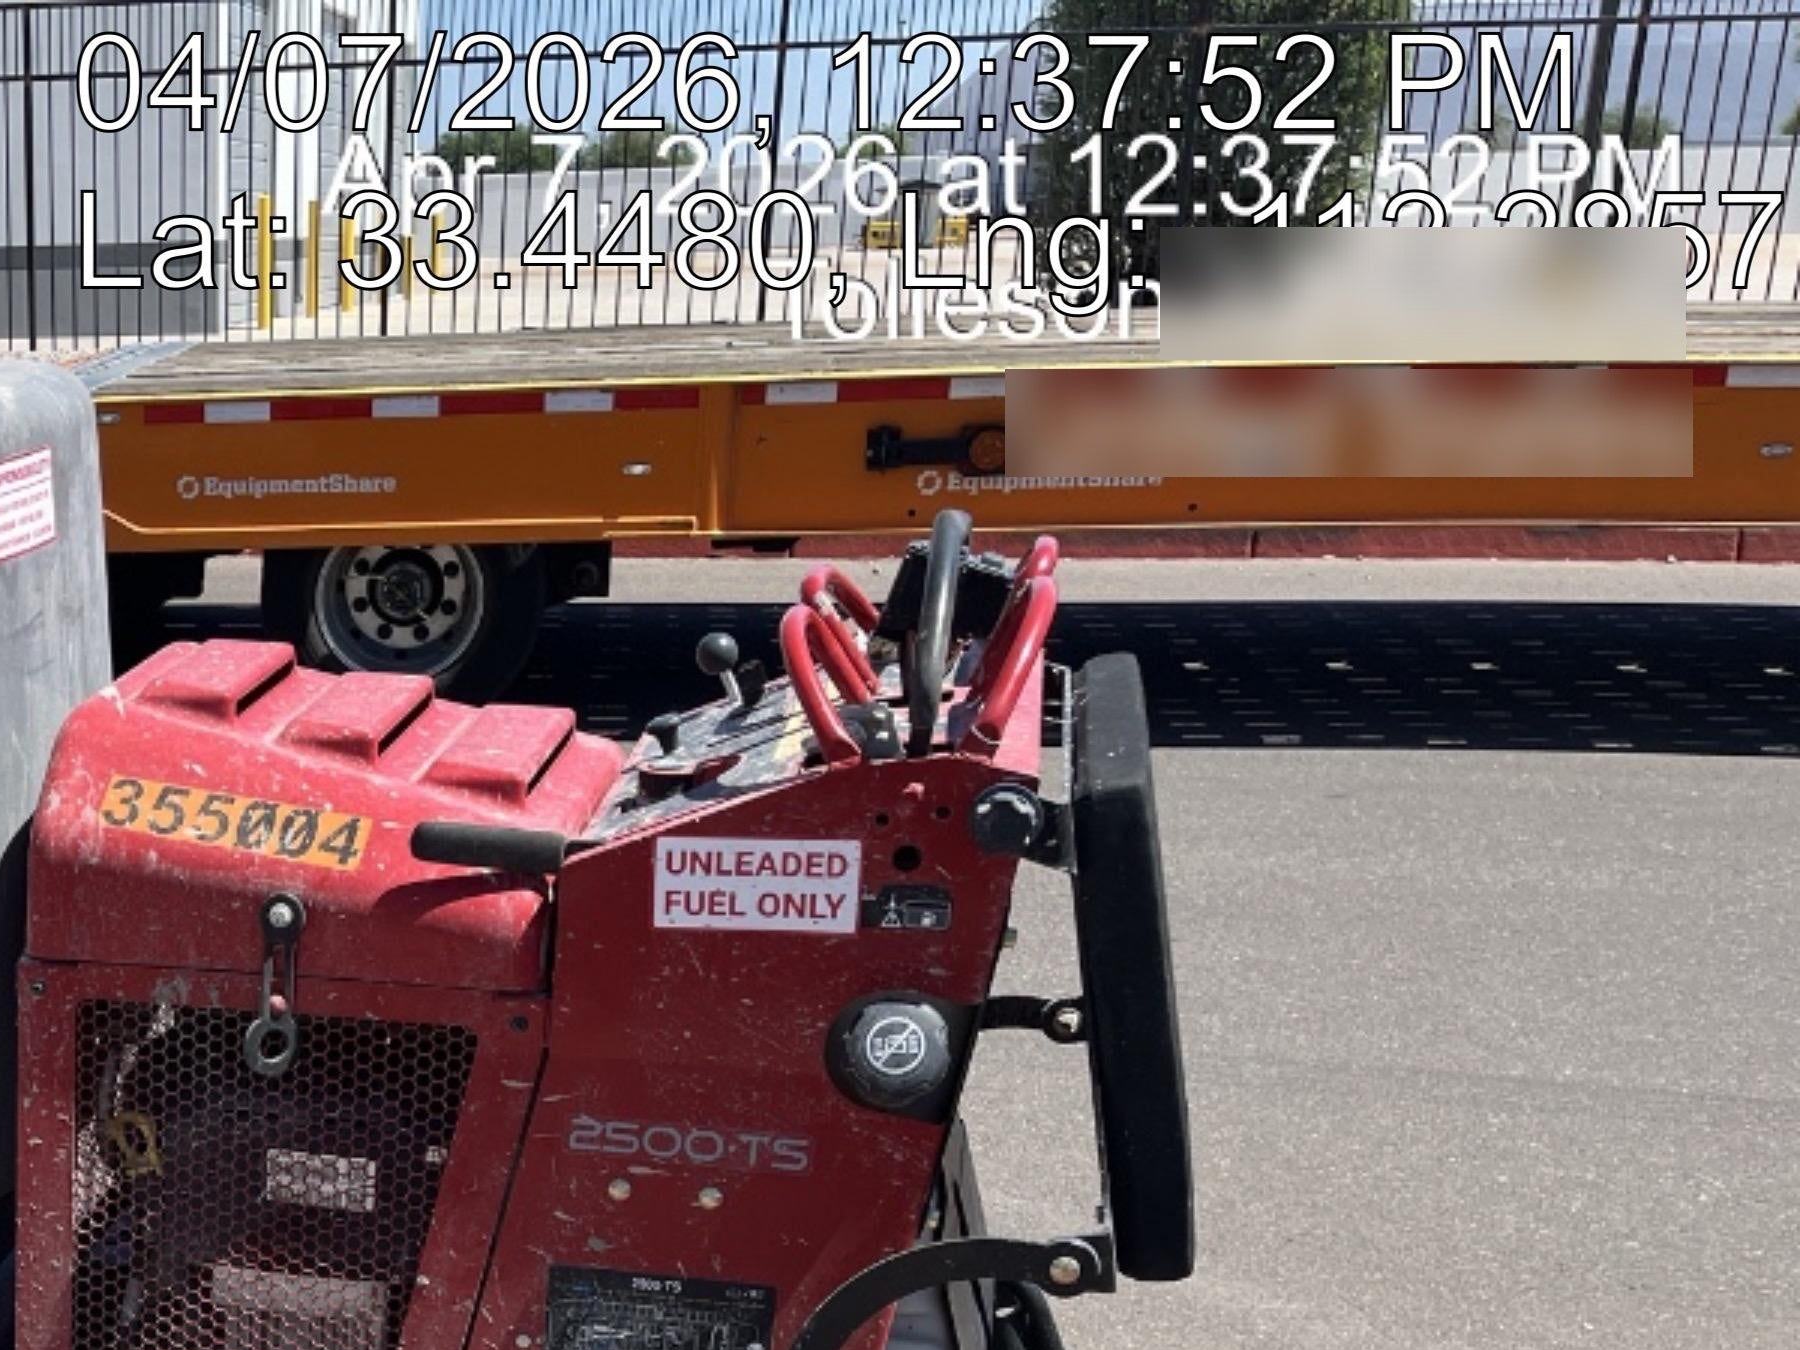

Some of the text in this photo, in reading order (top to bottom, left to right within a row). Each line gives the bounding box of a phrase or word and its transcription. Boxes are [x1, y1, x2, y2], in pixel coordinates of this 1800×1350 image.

[203, 474, 397, 498] EquipmentShare
[103, 779, 362, 865] 355004
[665, 851, 848, 878] UNLEADED
[665, 891, 847, 919] FUEL ONLY
